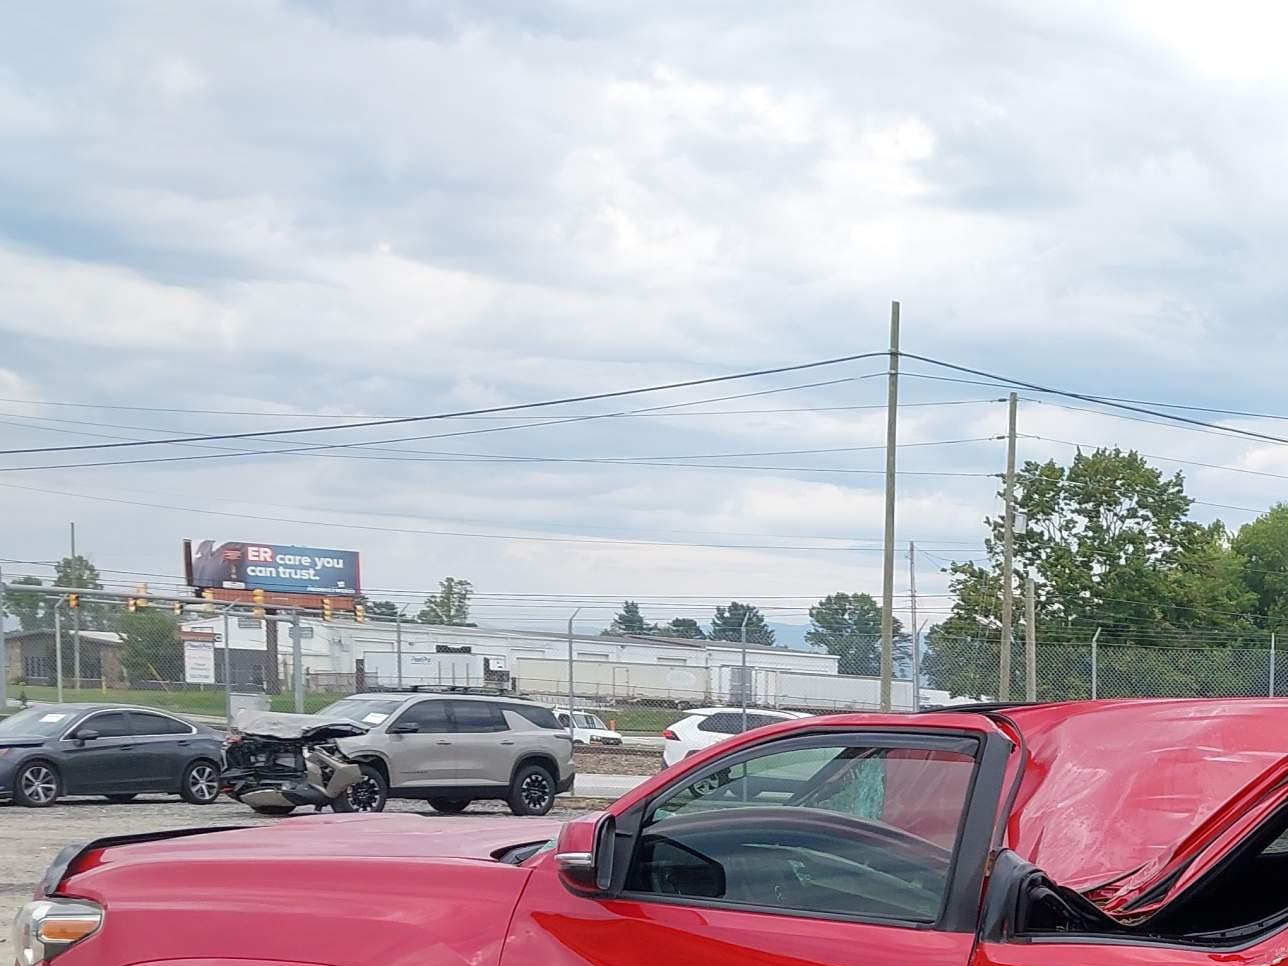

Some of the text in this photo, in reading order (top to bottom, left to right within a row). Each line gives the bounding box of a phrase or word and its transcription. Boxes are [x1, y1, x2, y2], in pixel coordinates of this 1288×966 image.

[247, 546, 273, 562] ER
[276, 552, 312, 565] care
[315, 556, 344, 570] you
[247, 566, 320, 581] can trust.
